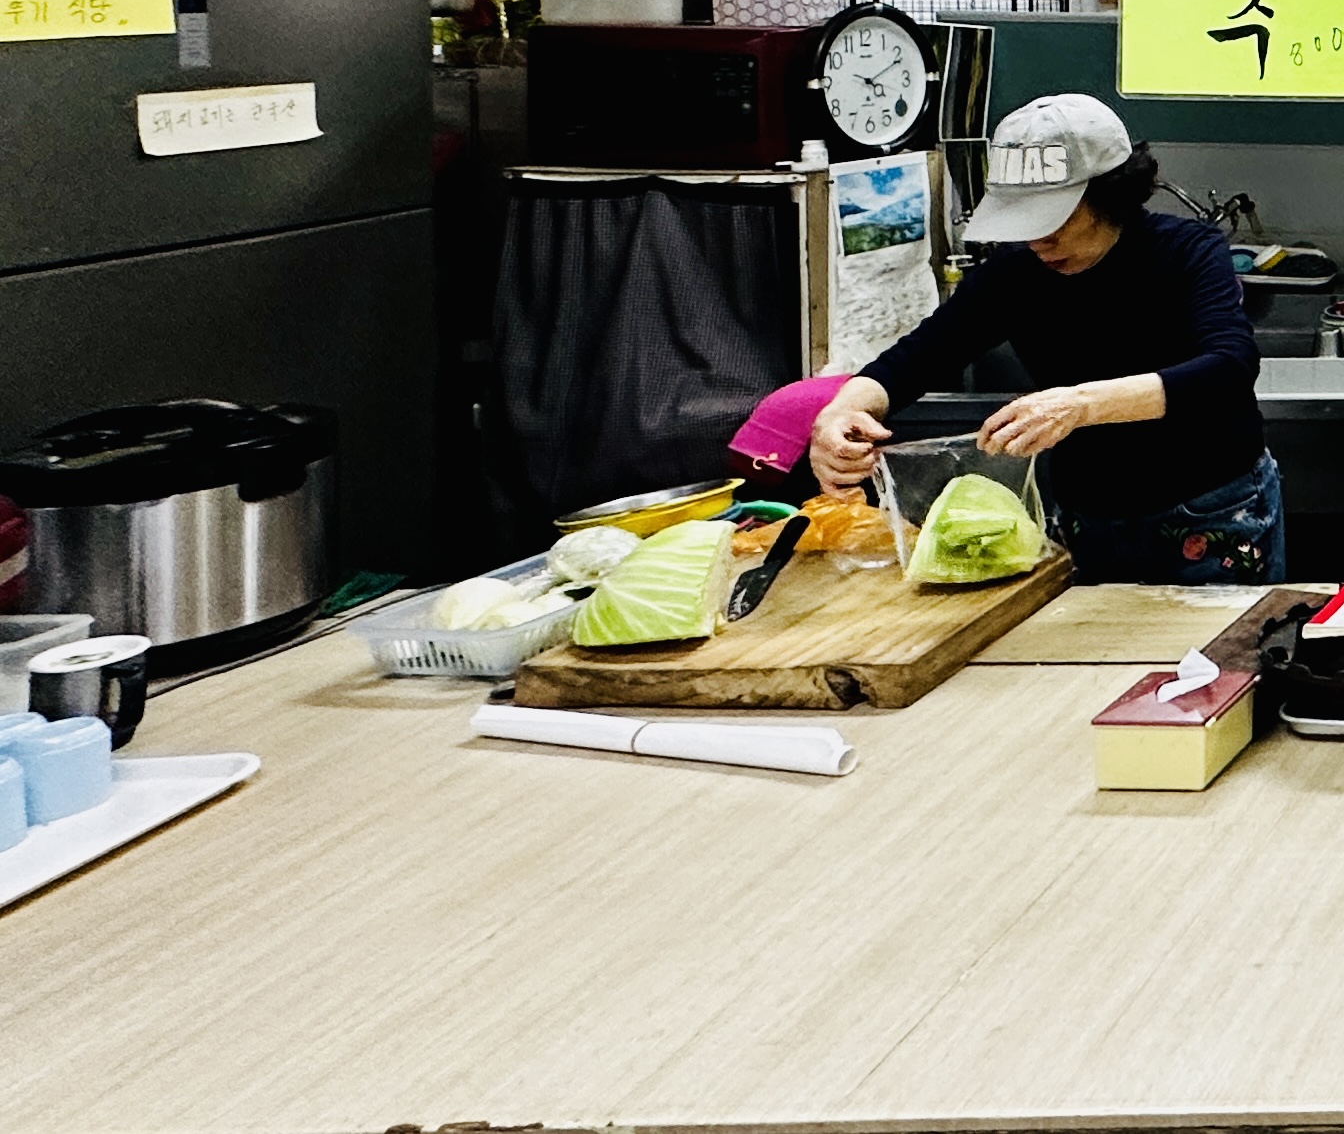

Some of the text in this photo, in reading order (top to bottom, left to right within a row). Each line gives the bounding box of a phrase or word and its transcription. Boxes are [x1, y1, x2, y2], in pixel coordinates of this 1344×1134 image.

[844, 34, 855, 54] 11
[859, 28, 872, 48] 12
[828, 51, 843, 71] 10
[892, 45, 904, 65] 2
[901, 69, 912, 88] 3
[831, 98, 841, 118] 8
[882, 108, 893, 127] 5
[848, 111, 858, 131] 7
[865, 115, 876, 134] 6
